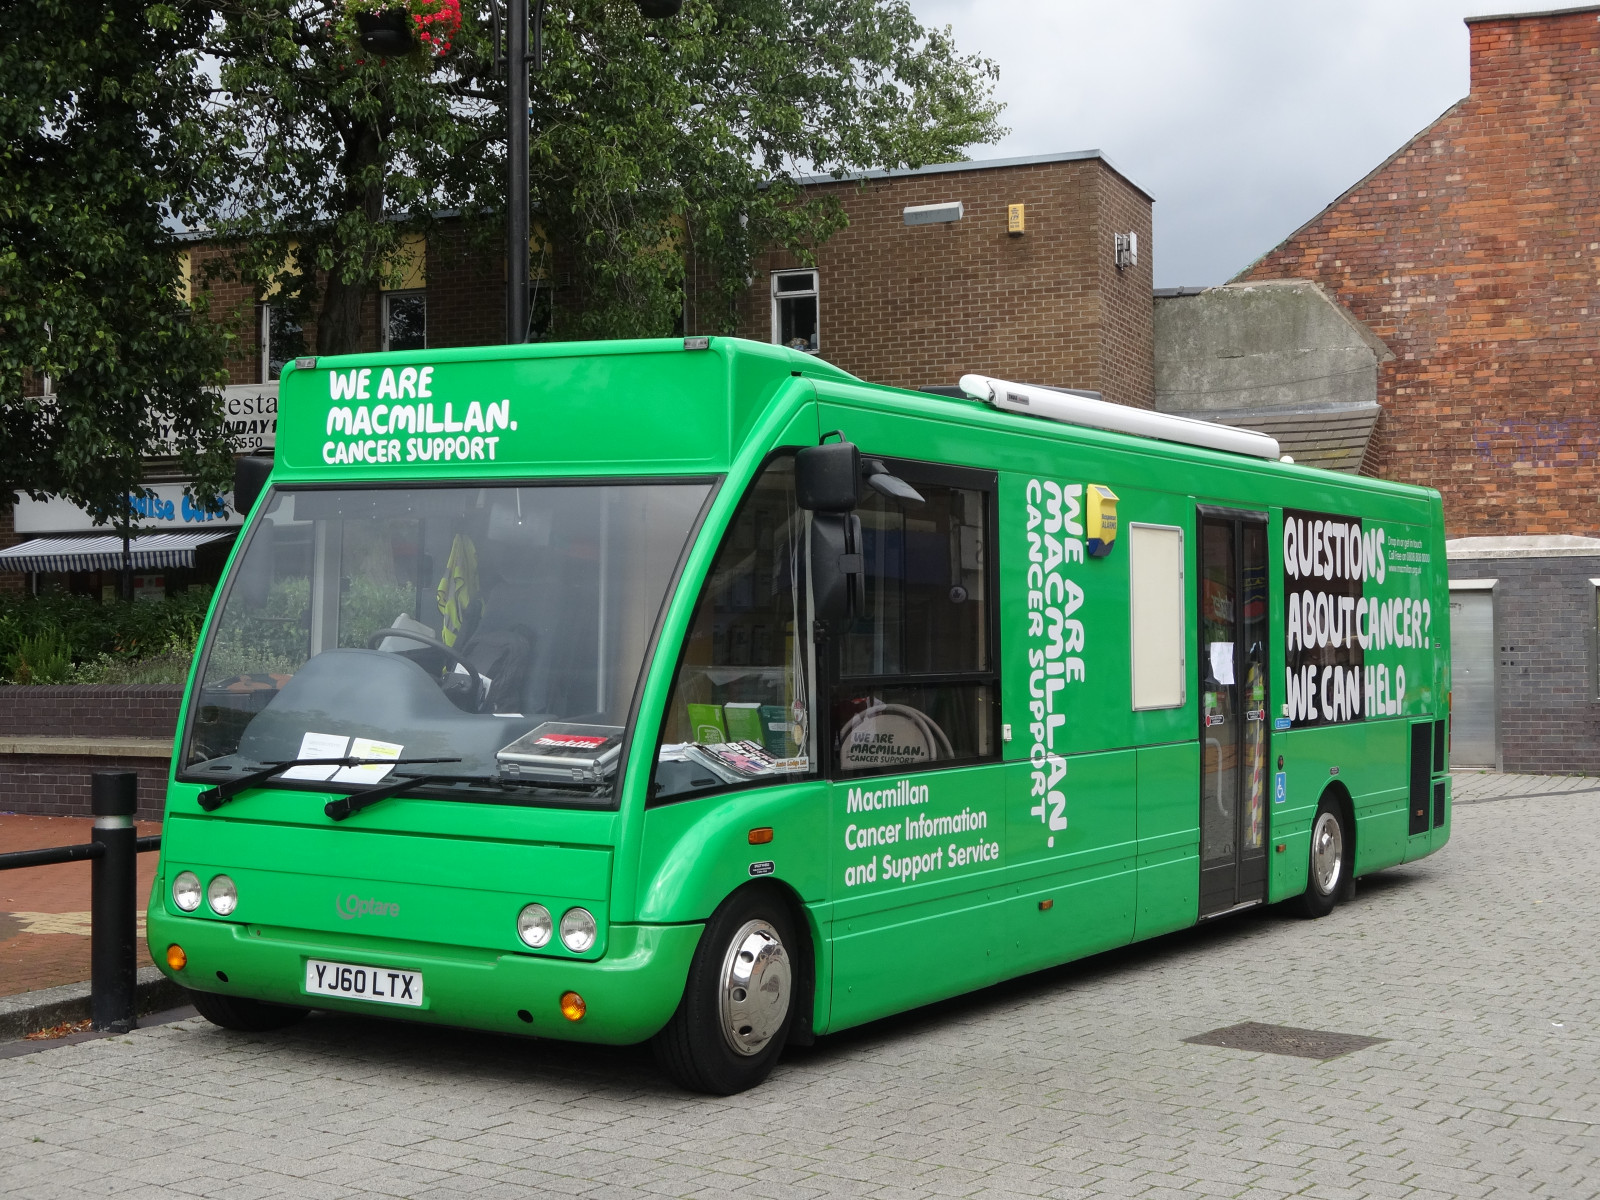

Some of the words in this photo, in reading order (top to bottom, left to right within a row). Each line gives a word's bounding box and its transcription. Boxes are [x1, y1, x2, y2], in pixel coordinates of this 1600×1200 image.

[330, 369, 372, 400] WE
[377, 366, 434, 399] ARE
[326, 399, 518, 436] MACMILLAN.
[322, 439, 401, 464] CANCER
[406, 436, 499, 461] SUPPORT
[1064, 484, 1084, 565] WE
[1026, 479, 1044, 637] CANCER
[1283, 516, 1385, 584] QUESTIONS
[1065, 579, 1085, 683] ARE
[1288, 590, 1354, 651] ABOUT
[1356, 598, 1431, 650] CANCER?
[1044, 481, 1067, 848] MACMILLAN.
[1286, 665, 1318, 721] WE
[1320, 665, 1360, 722] CAN
[1364, 663, 1406, 717] HELP
[535, 737, 598, 749] makita
[850, 743, 925, 757] MACMILLAN.
[854, 733, 870, 743] WE
[873, 733, 894, 743] ARE
[1029, 648, 1046, 824] SUPPORT
[849, 754, 878, 763] CANCER
[880, 755, 915, 764] SUPPORT
[846, 779, 929, 814] Macmillan
[845, 824, 902, 851] Cancer
[905, 806, 987, 841] Information
[845, 855, 877, 887] and
[882, 846, 943, 883] Support
[948, 838, 999, 868] Service
[346, 893, 400, 918] Optare
[315, 964, 366, 994] YJ60
[372, 971, 414, 1000] LTX
